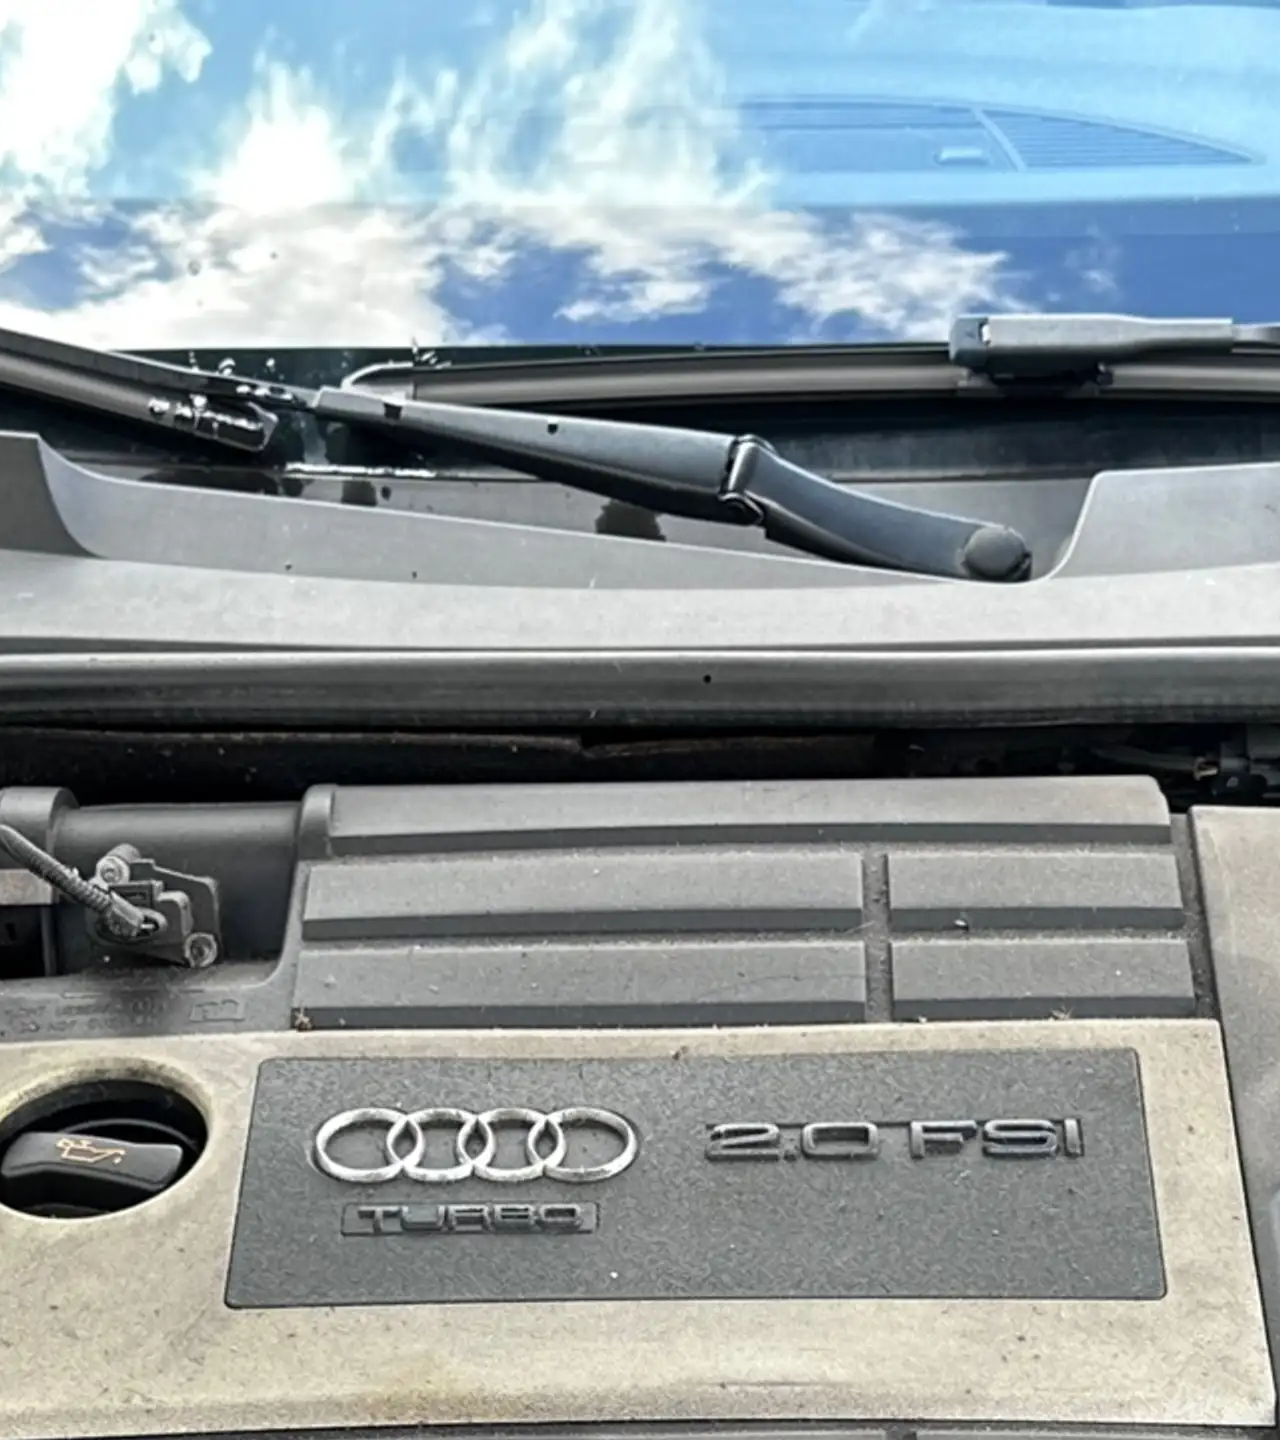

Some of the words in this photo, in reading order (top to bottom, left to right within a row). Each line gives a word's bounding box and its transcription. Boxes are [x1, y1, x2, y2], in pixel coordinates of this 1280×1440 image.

[706, 1121, 880, 1162] 2.0
[909, 1118, 1084, 1159] FSI
[356, 1203, 584, 1236] TURBO
